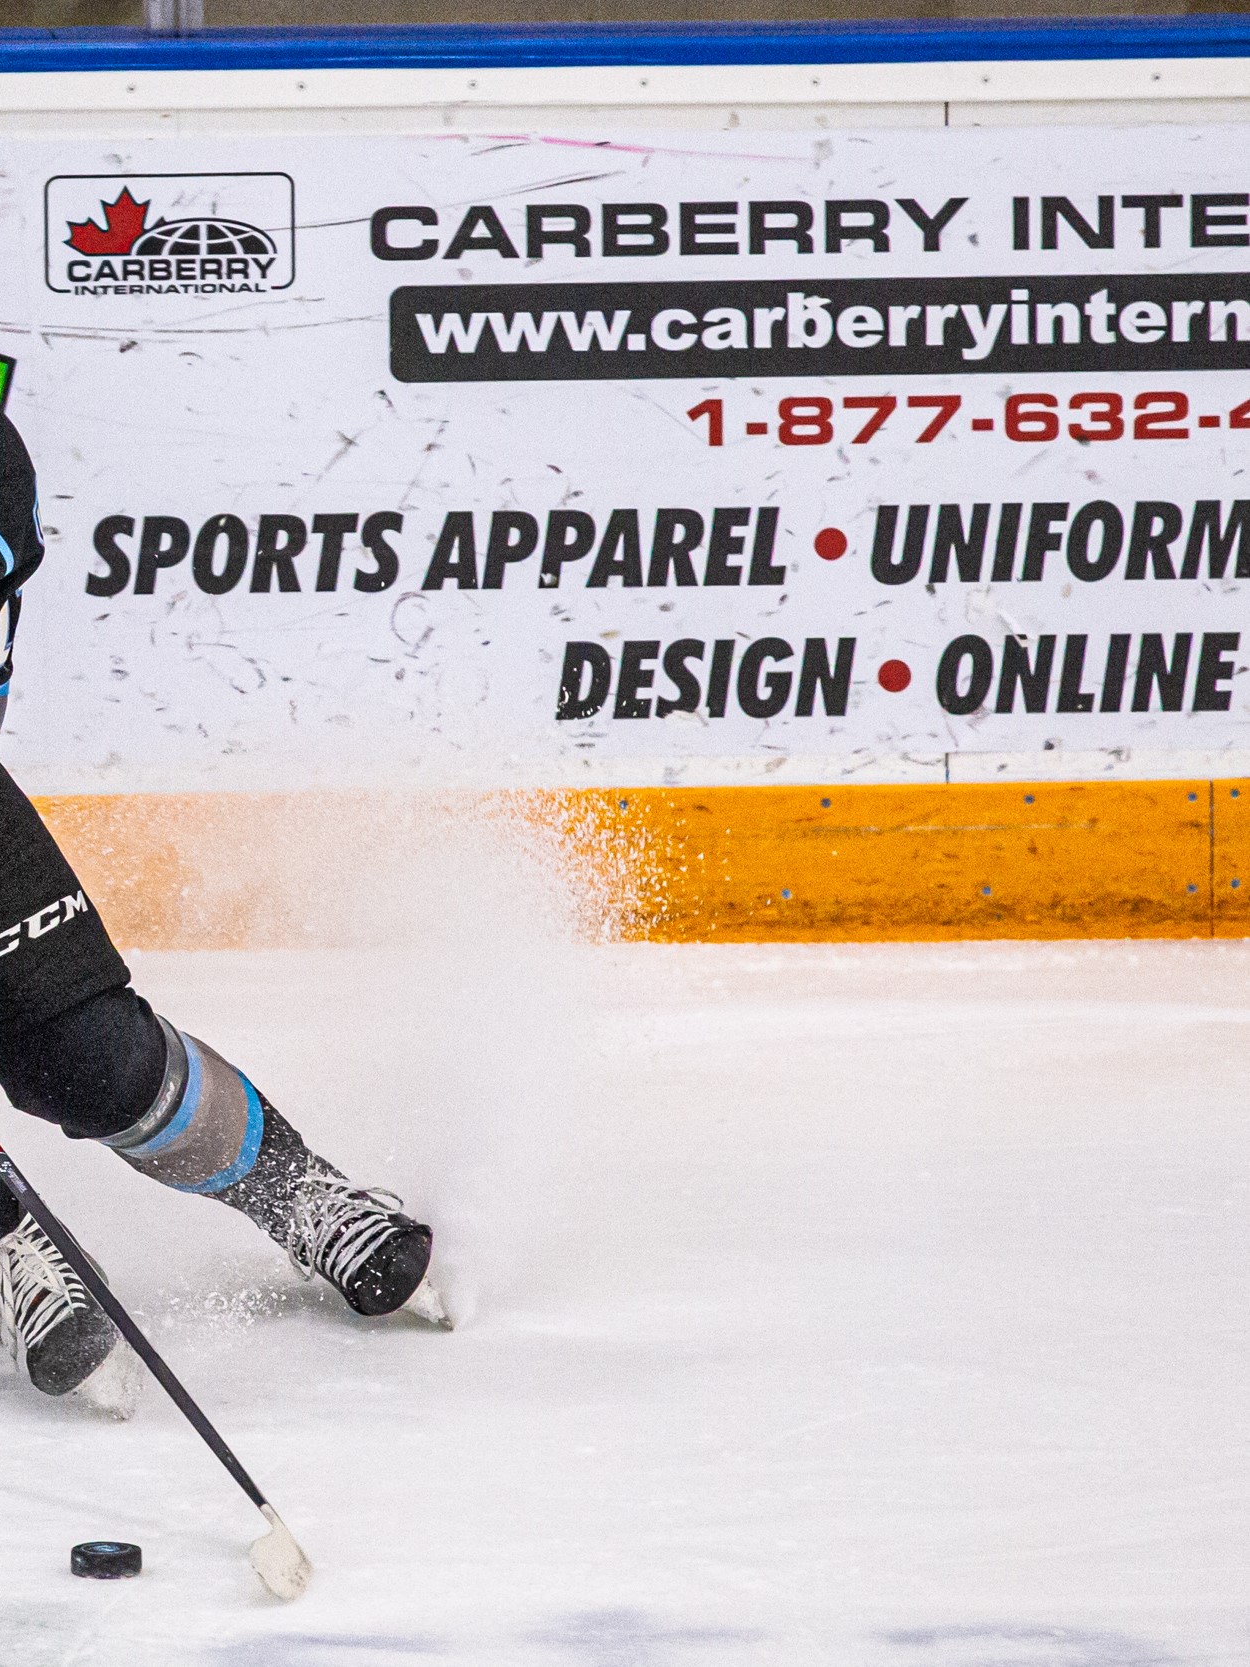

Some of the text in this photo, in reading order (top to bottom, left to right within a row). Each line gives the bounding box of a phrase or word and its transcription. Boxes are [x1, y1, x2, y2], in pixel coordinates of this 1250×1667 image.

[369, 194, 1250, 261] CARBERRY INTE
[66, 256, 277, 283] CARBERRY
[74, 281, 268, 296] INTERNATIONAL
[415, 289, 1250, 360] www.carberryintern
[85, 499, 1250, 598] SPORTS APPAREL UNIFORM
[556, 632, 1241, 721] DESIGN ONLINE
